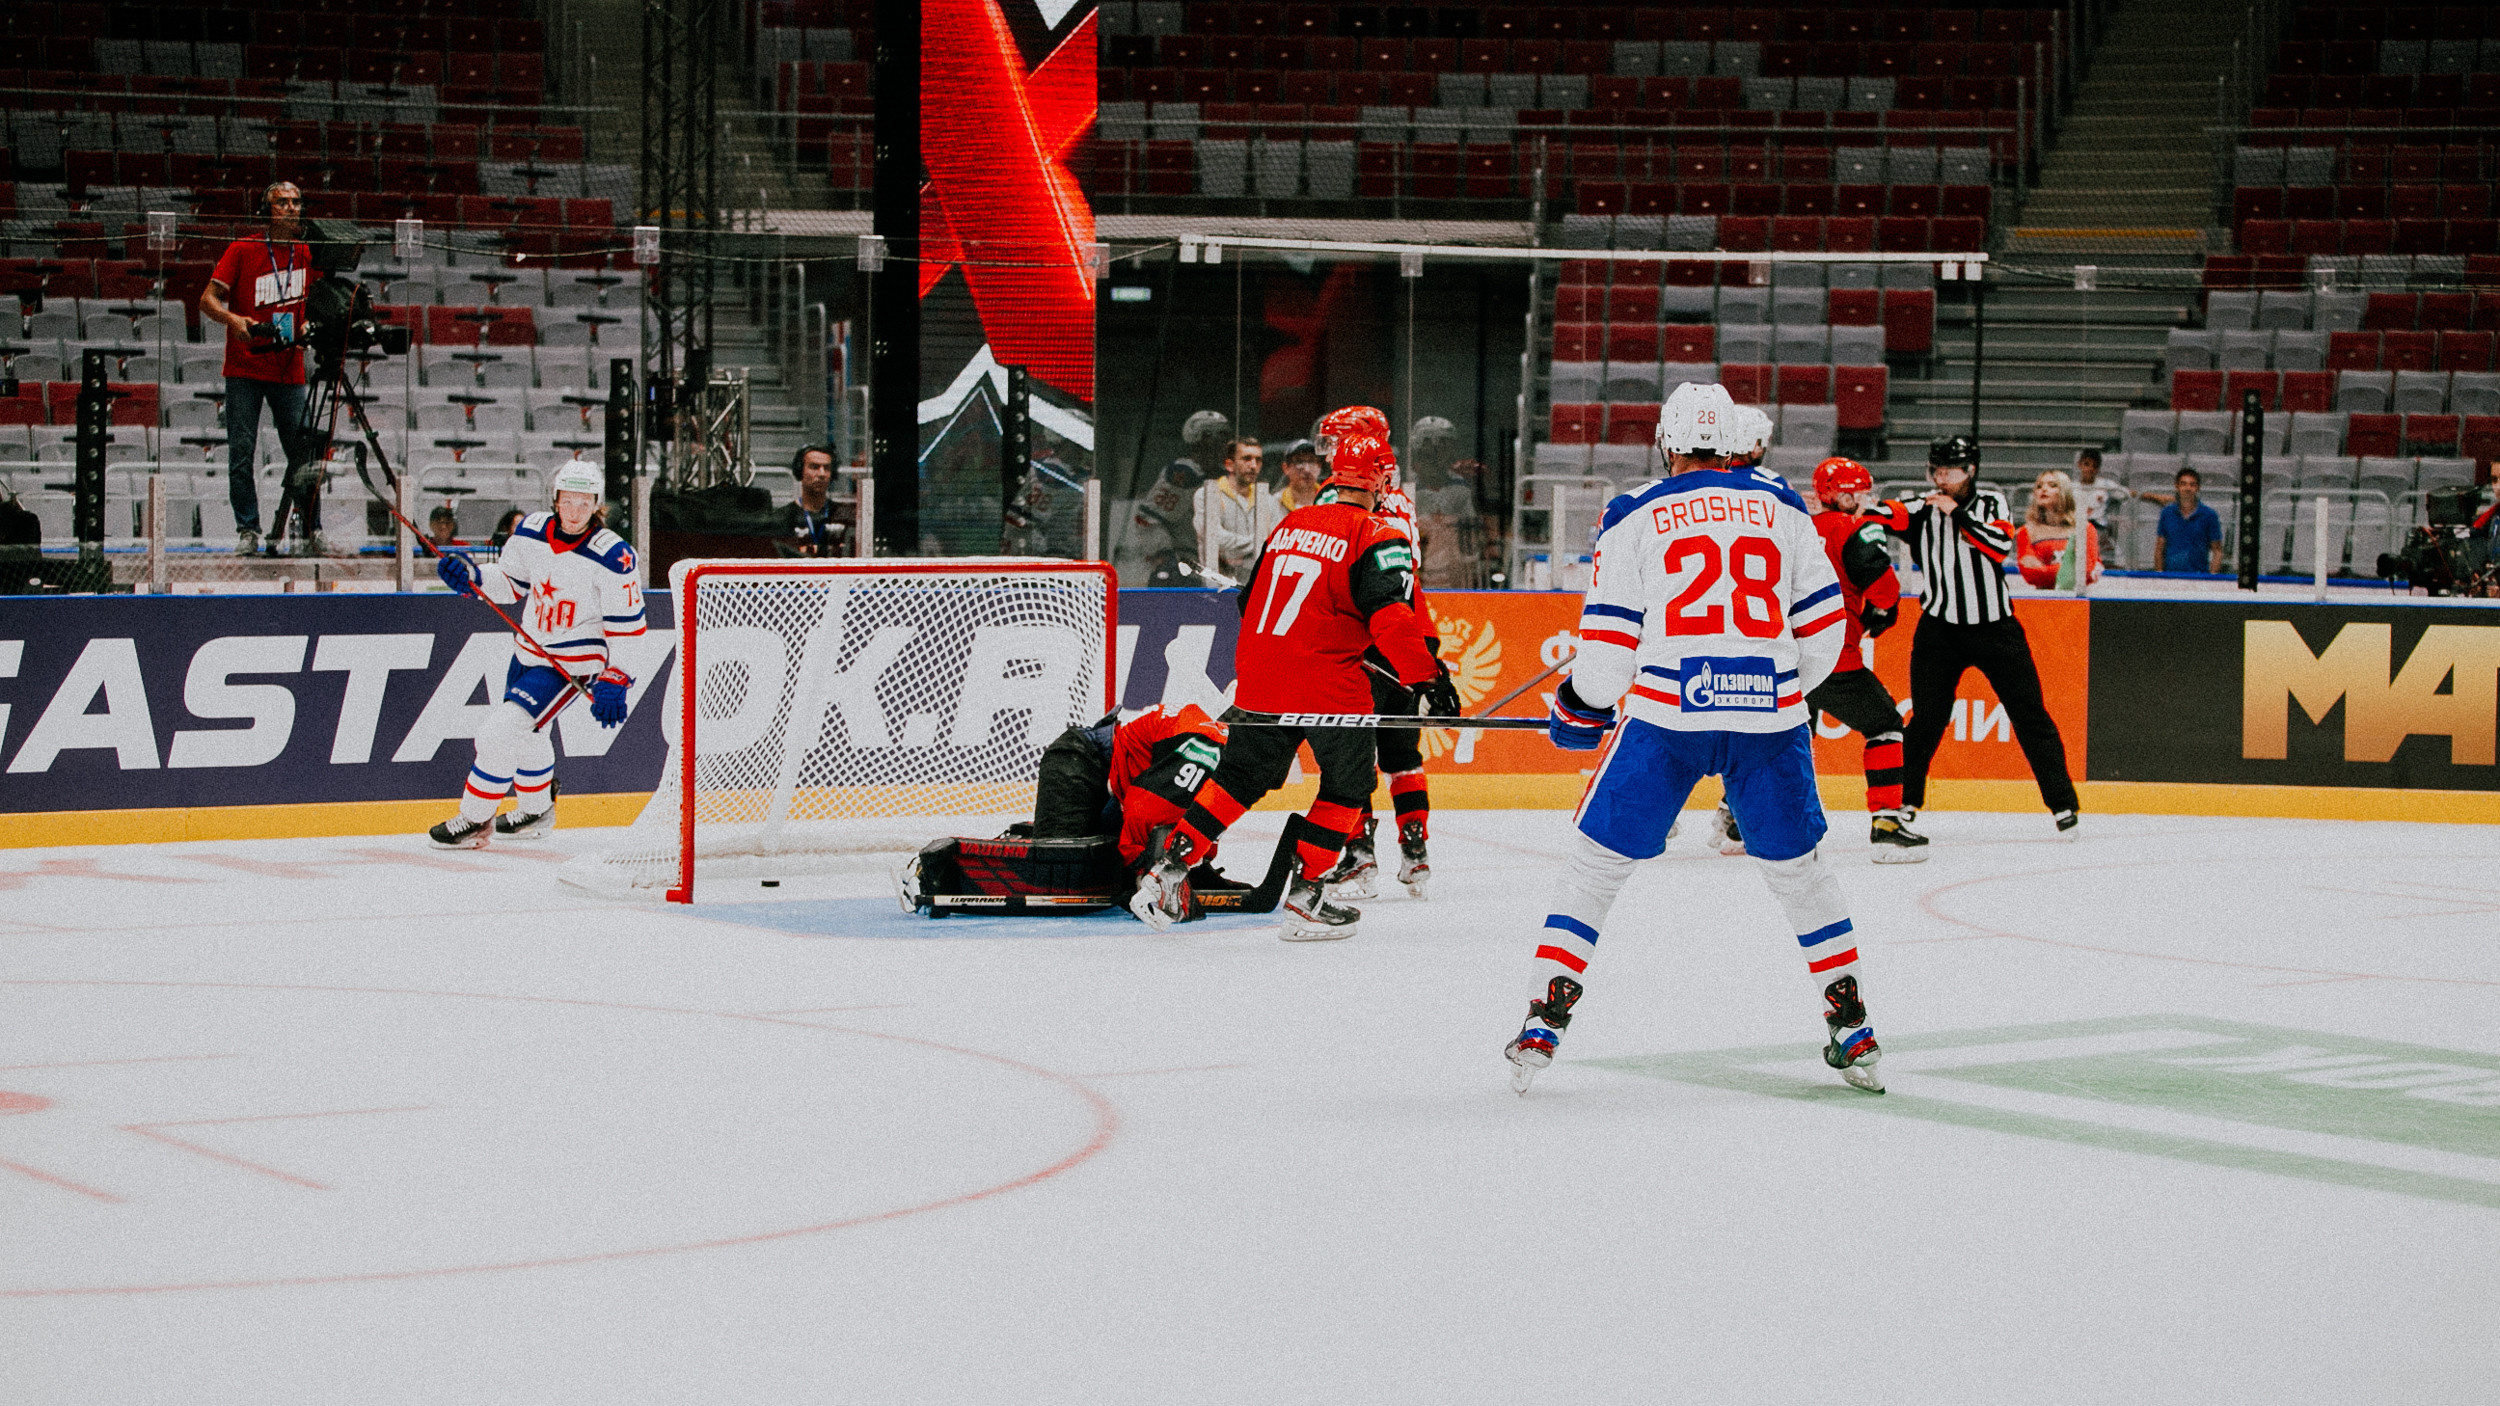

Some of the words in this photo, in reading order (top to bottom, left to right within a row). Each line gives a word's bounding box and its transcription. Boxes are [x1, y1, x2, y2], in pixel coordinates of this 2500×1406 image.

[1697, 410, 1716, 424] 28
[1652, 496, 1775, 534] GROSHEV
[1266, 527, 1349, 562] ДЬЯЧЕНКО
[1256, 554, 1322, 636] 17
[1664, 535, 1785, 639] 28
[1713, 674, 1774, 692] ГАЗПРОМ
[0, 624, 1217, 774] ASTAVOK.RU
[1717, 696, 1772, 705] ЭКСПОРТ
[1278, 712, 1382, 727] BAUER
[1174, 763, 1206, 792] 91
[960, 841, 1029, 858] VAUGHN
